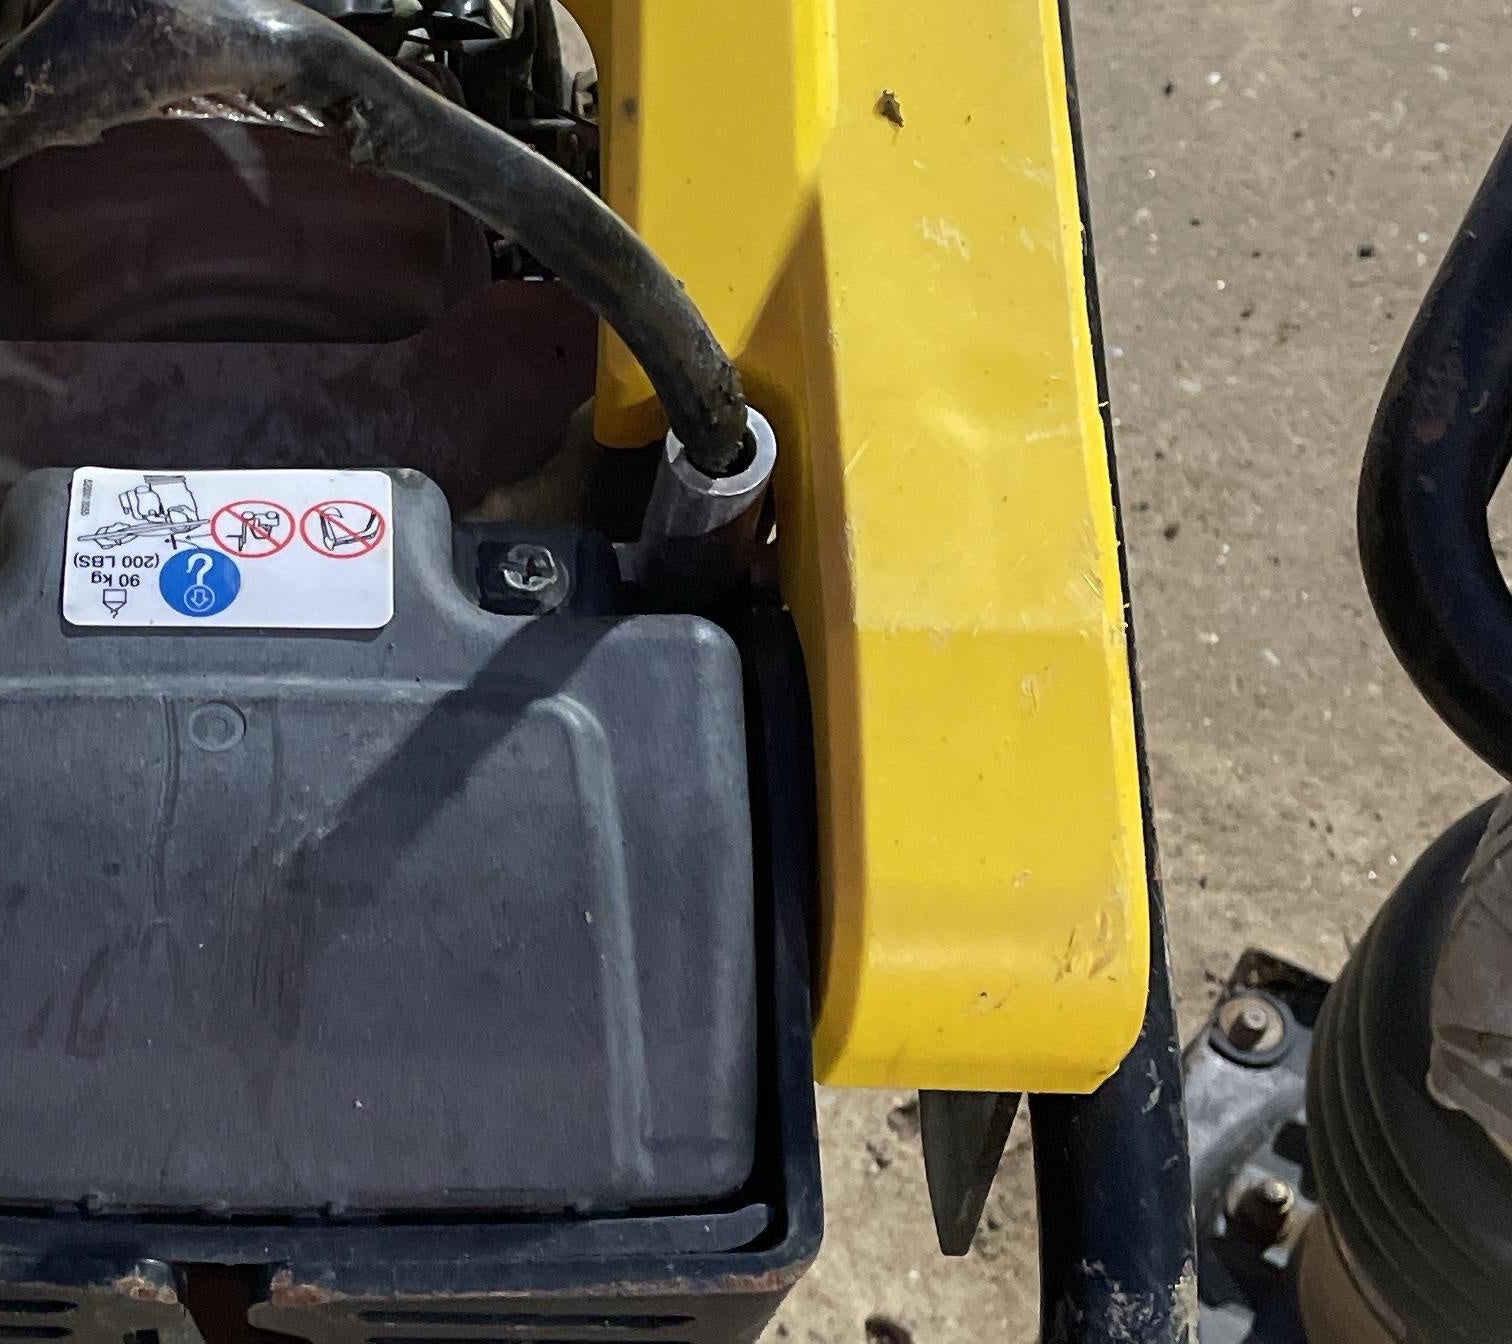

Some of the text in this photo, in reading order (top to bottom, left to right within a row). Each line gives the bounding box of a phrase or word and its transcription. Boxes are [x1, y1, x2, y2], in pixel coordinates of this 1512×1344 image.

[73, 551, 160, 569] (200 LBS)
[91, 570, 140, 588] 90 kg
